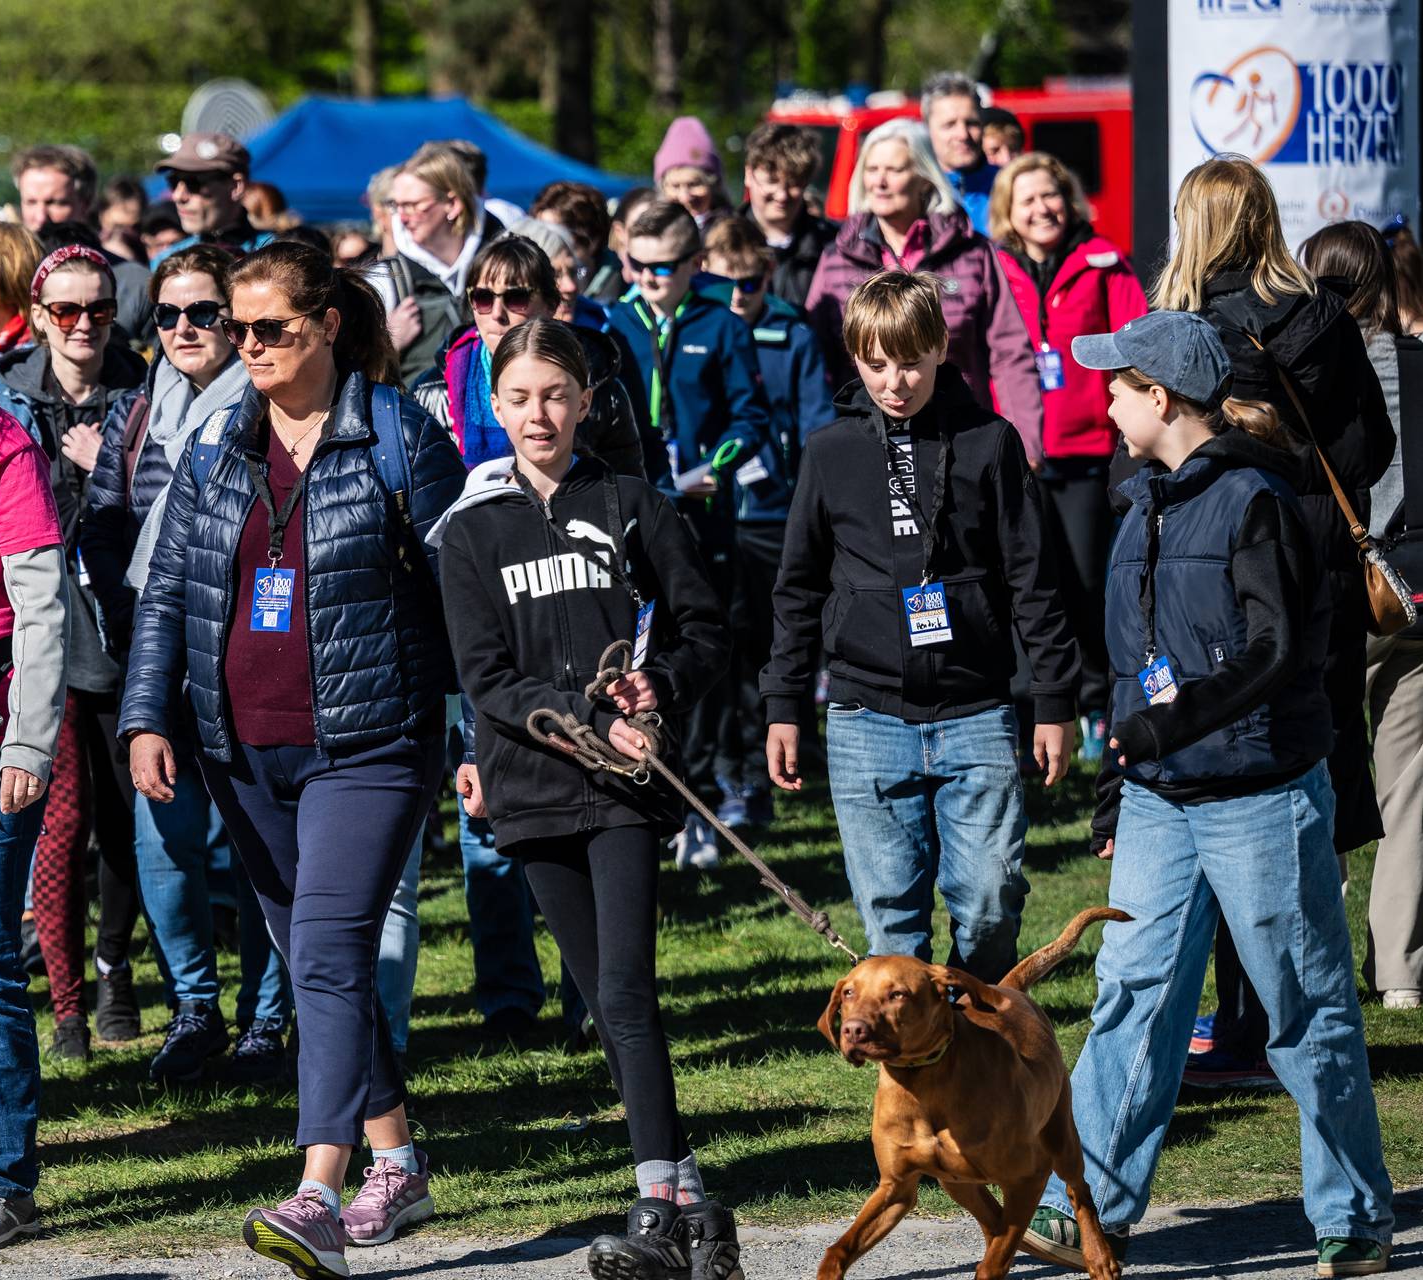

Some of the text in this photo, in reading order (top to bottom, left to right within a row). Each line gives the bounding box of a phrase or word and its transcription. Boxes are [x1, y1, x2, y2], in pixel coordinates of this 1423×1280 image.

[1306, 62, 1402, 115] 1000
[1306, 111, 1402, 165] HERZEN
[274, 577, 292, 587] 1000
[500, 552, 612, 605] PUMA
[923, 591, 943, 603] 1000
